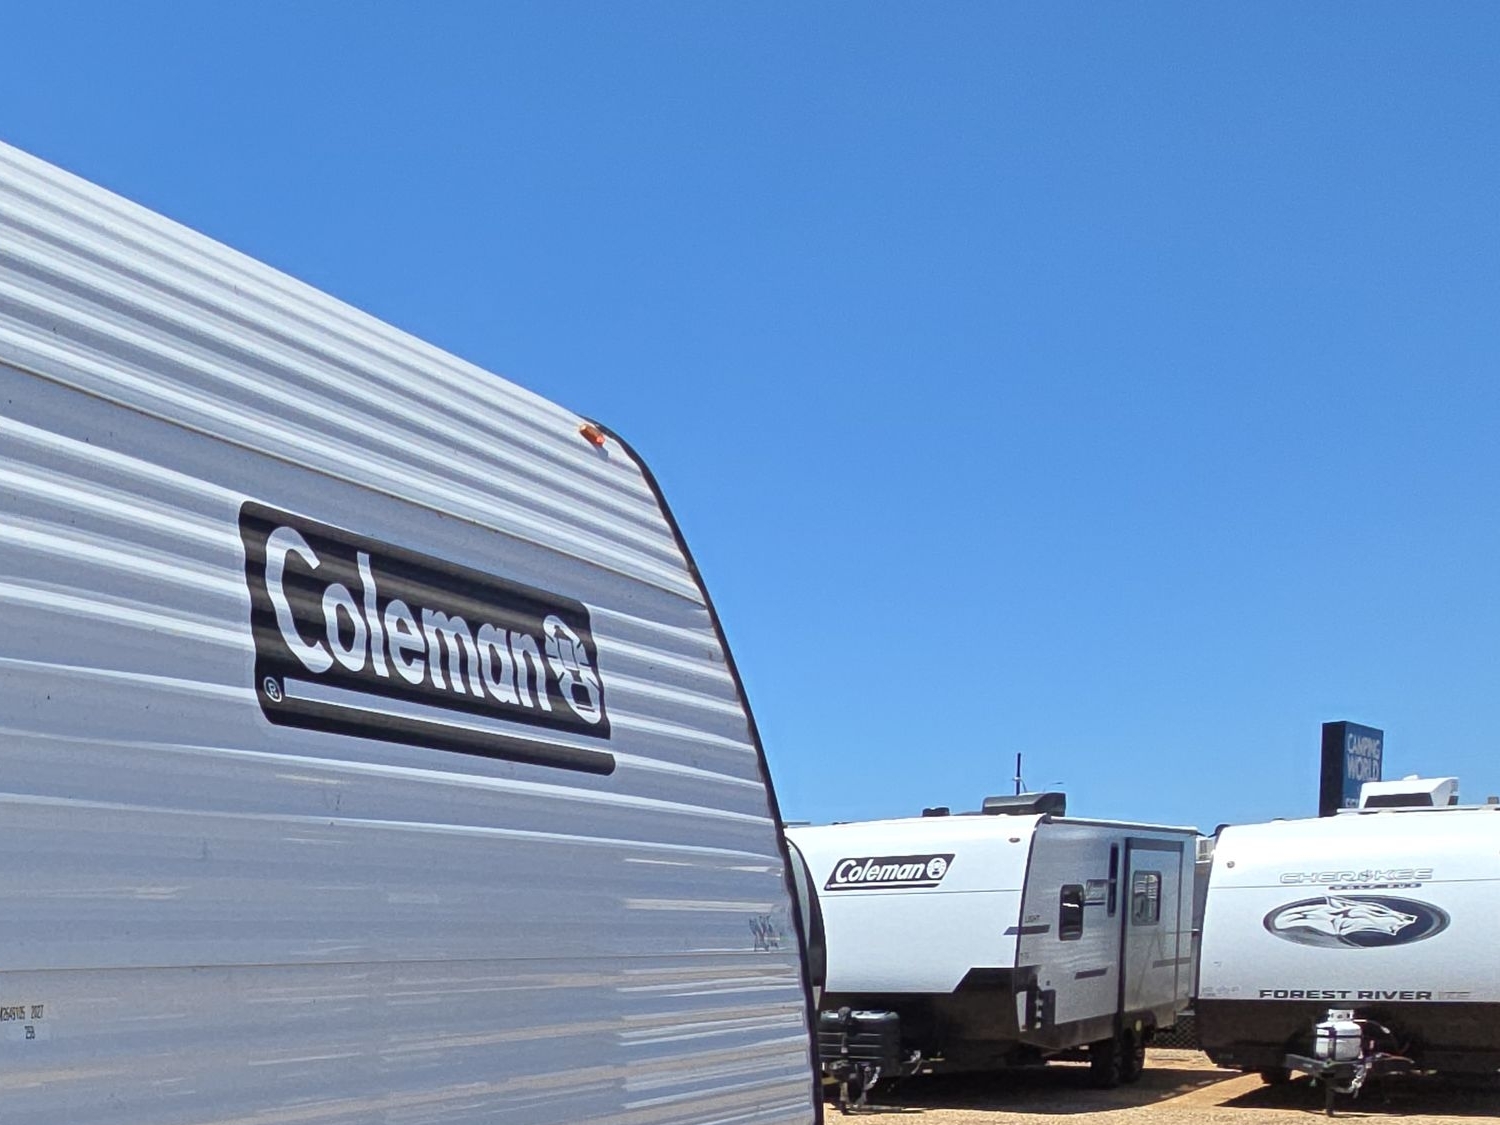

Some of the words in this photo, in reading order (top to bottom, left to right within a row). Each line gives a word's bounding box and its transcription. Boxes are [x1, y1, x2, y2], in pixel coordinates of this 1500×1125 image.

[265, 526, 552, 712] Coleman
[1346, 753, 1380, 782] WORLD
[836, 859, 926, 883] Coleman
[1280, 868, 1434, 884] CHEROKEE
[1259, 990, 1351, 999] FOREST
[1357, 990, 1432, 1000] RIVER
